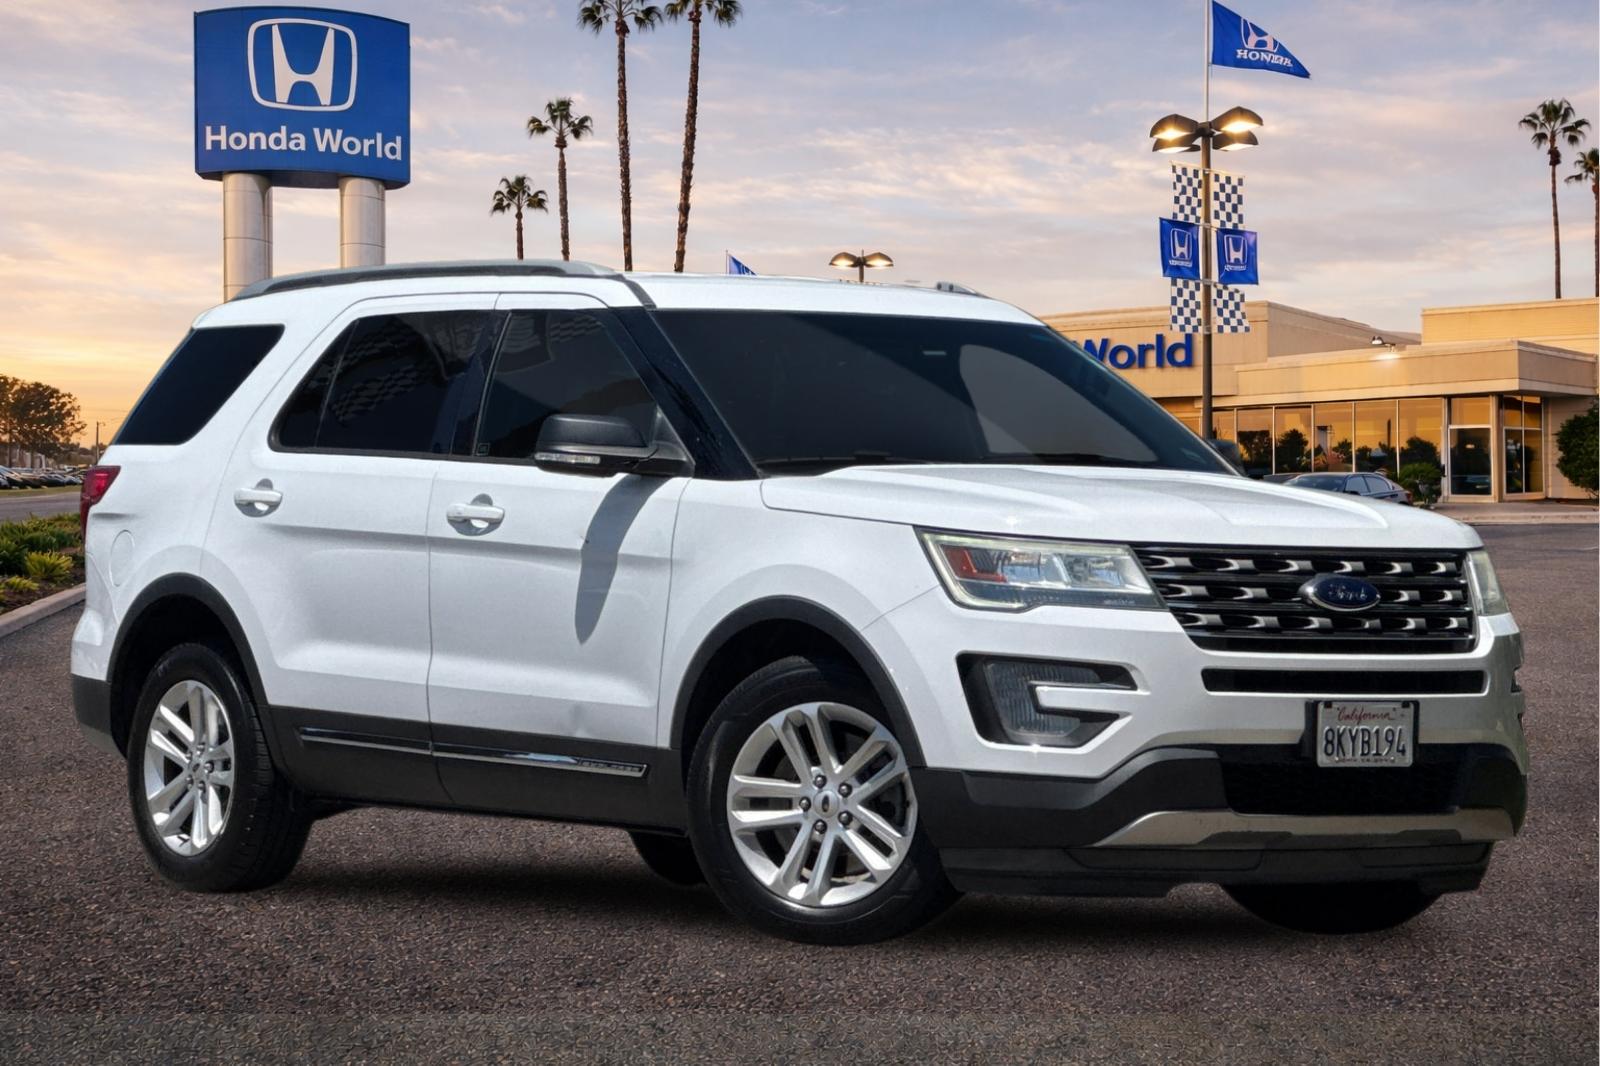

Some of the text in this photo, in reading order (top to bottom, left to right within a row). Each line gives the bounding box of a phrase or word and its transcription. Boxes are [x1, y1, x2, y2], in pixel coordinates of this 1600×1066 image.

[205, 125, 402, 160] Honda World
[1337, 706, 1395, 725] California
[1323, 726, 1406, 757] 8KYB194
